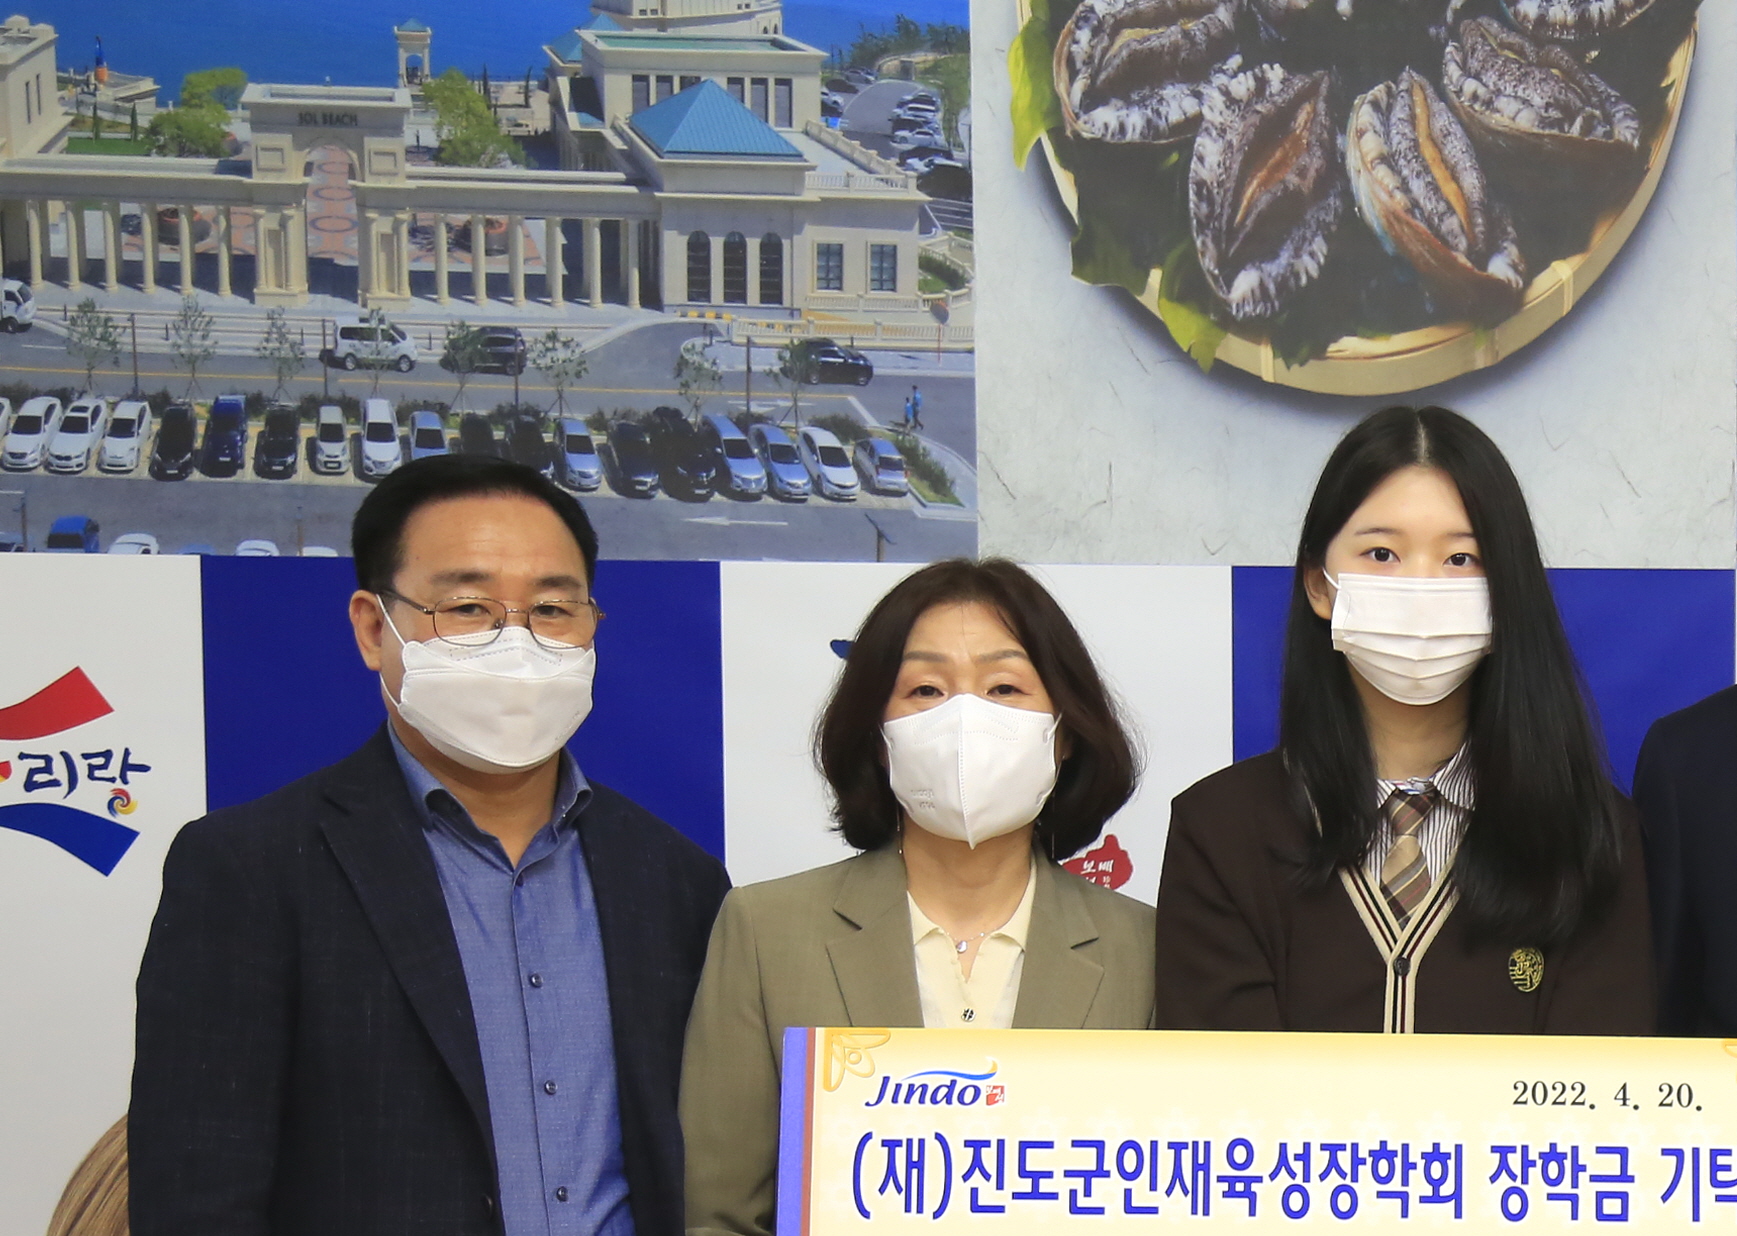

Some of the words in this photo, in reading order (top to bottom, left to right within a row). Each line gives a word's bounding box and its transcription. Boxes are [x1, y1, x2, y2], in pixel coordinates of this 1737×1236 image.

[0, 747, 152, 818] 리랑
[865, 1075, 982, 1107] Jindo
[1513, 1081, 1596, 1110] 2022.
[1613, 1082, 1640, 1111] 4.
[1658, 1083, 1703, 1112] 20.
[852, 1131, 1463, 1220] (재)진도군인재육성장학회
[1489, 1142, 1635, 1223] 장학금
